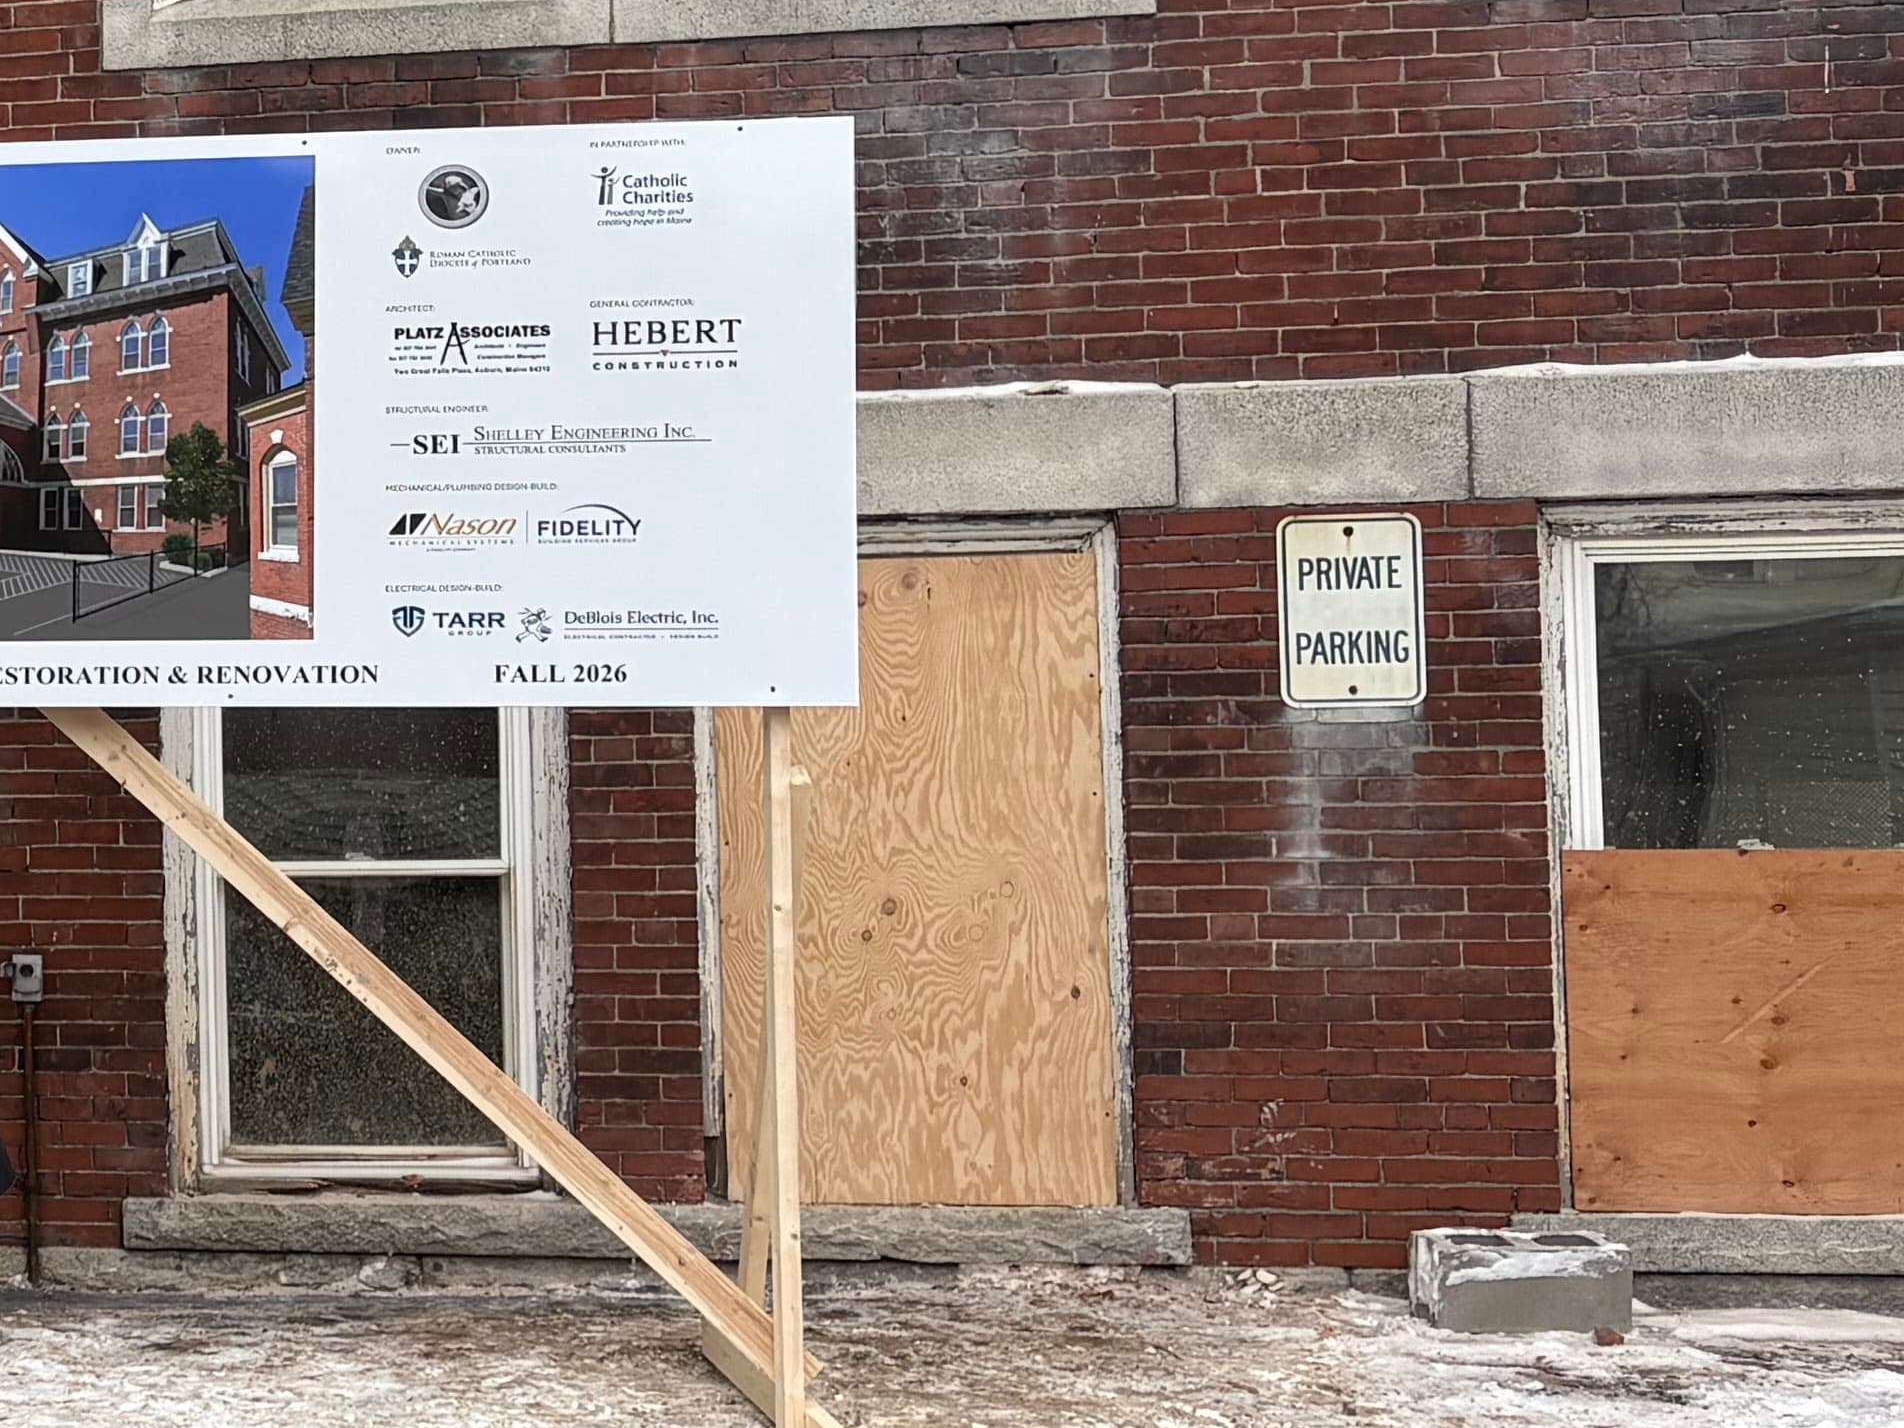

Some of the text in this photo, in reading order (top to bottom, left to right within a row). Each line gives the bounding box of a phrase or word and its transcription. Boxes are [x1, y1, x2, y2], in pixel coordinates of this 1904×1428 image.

[622, 173, 688, 188] Catholic
[622, 190, 694, 204] Charities
[589, 299, 630, 308] GENERAL
[592, 319, 742, 346] HEBERT
[394, 322, 551, 365] PLATZ ASSOCIATES
[593, 360, 738, 370] CONSTRUCTION
[385, 406, 441, 414] STRUCTURAL
[474, 425, 545, 441] SHELLEY
[551, 424, 658, 441] ENGINEERING
[412, 433, 462, 456] SEI
[474, 443, 627, 455] STRUCTURAL CONSULTANTS
[420, 512, 517, 535] Nason
[537, 519, 641, 536] FIDELITY
[1297, 555, 1402, 591] PRIVATE
[385, 584, 437, 593] ELECTRICAL
[432, 612, 506, 629] TARR
[564, 610, 719, 625] DeBlois Electric, Inc.
[1295, 629, 1410, 665] PARKING
[167, 666, 189, 684] &
[197, 664, 379, 684] RENOVATION
[495, 664, 566, 683] FALL
[573, 663, 628, 683] 2026
